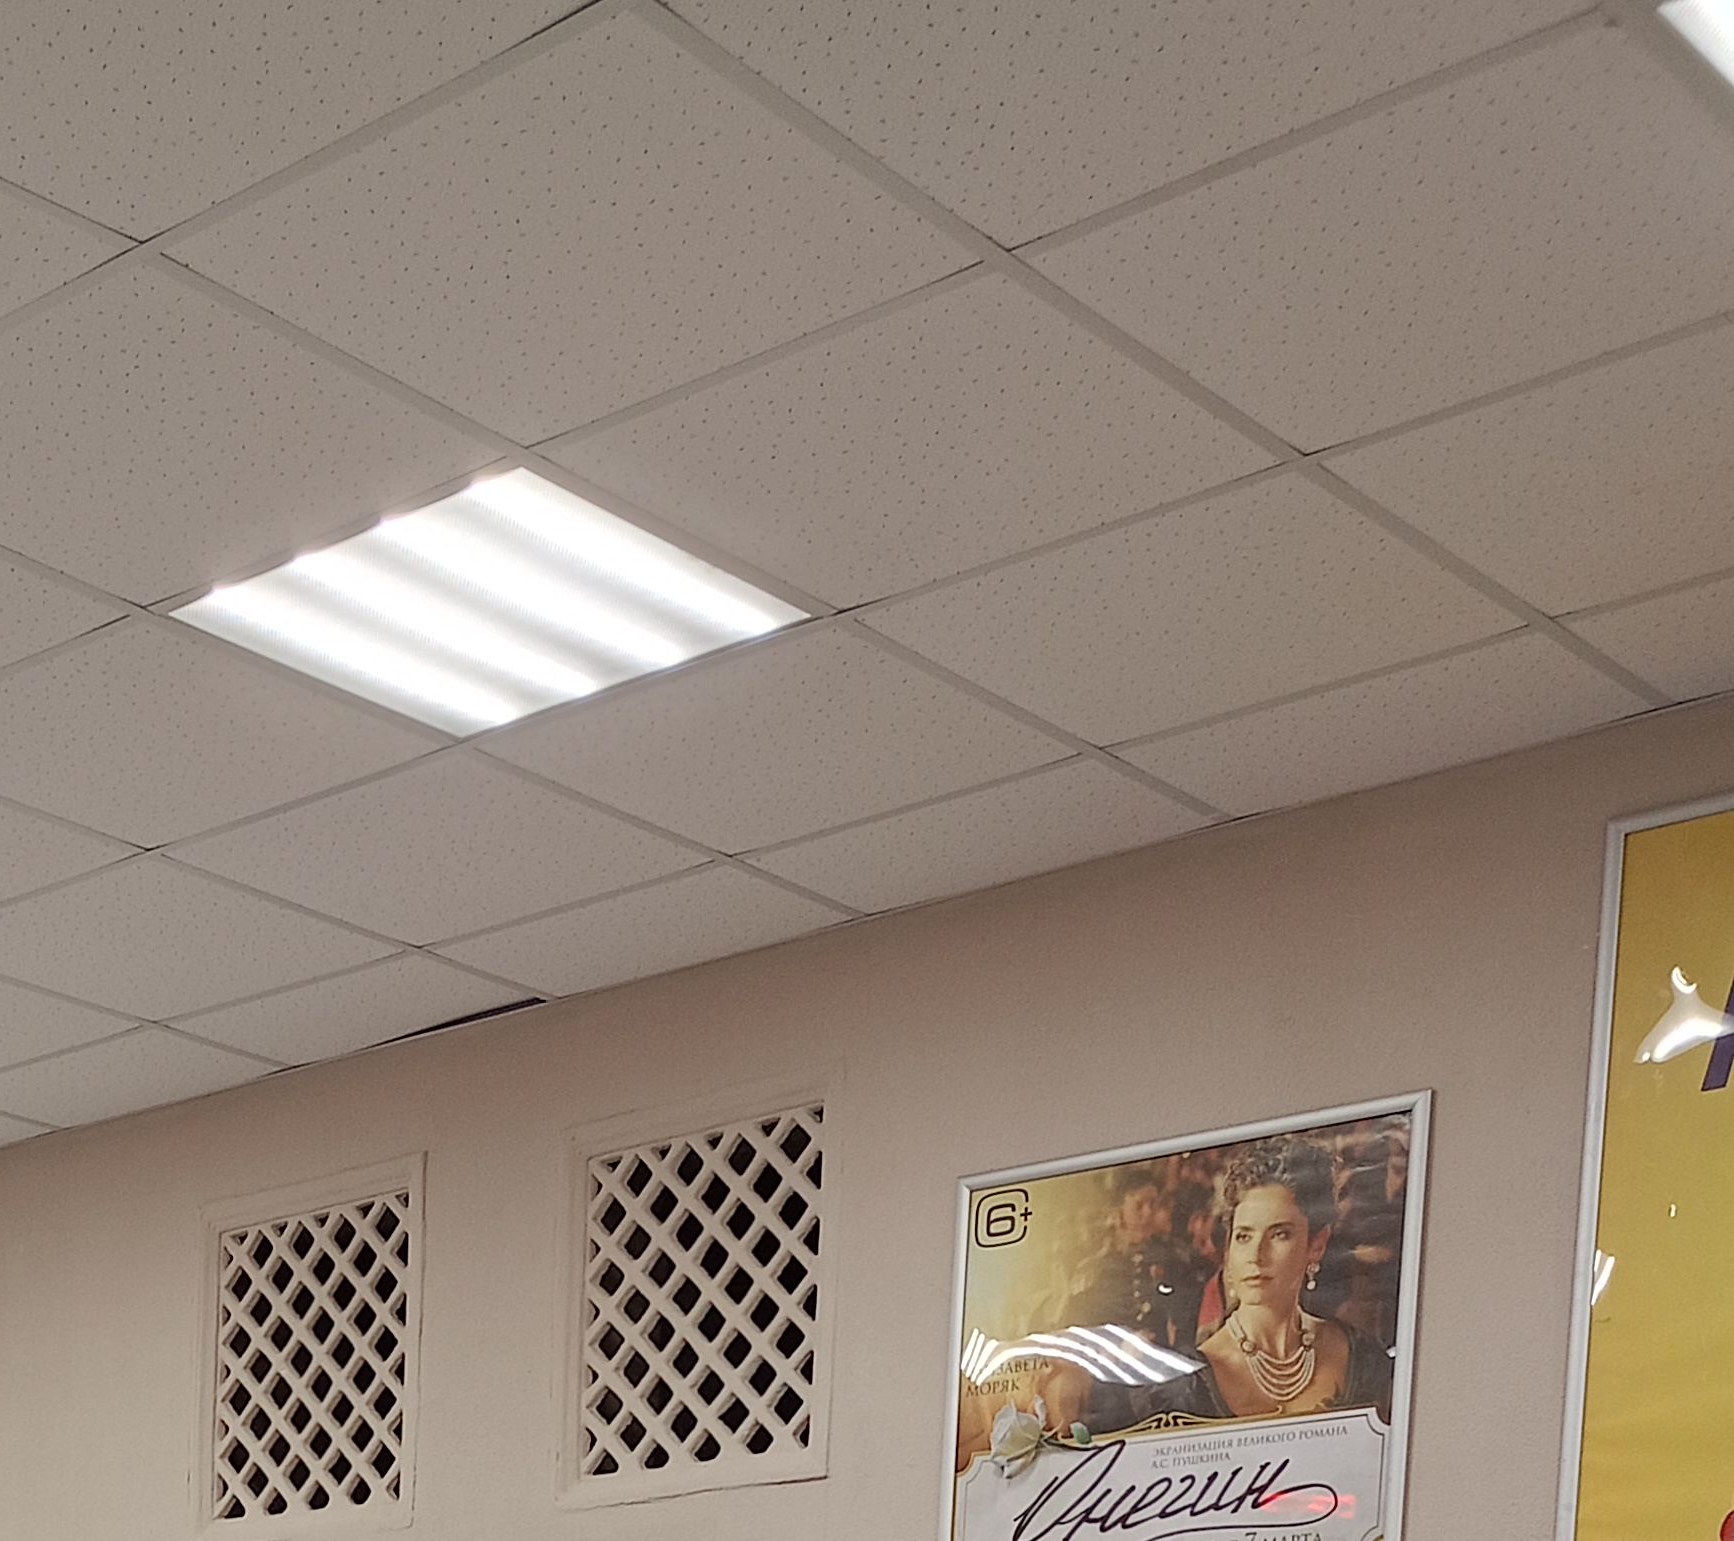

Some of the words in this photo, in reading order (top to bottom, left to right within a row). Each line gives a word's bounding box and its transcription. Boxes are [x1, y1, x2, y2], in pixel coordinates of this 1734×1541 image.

[986, 1202, 1033, 1237] 6+
[991, 1355, 1049, 1376] ЗАВЕТА
[965, 1377, 1020, 1398] МОРЯК
[1154, 1437, 1234, 1457] ЭКРАНИЗАЦИЯ
[1236, 1432, 1297, 1447] ВЕЛИКОГО
[1298, 1425, 1348, 1441] РОМАНА
[1172, 1451, 1231, 1467] ПУШКИНА
